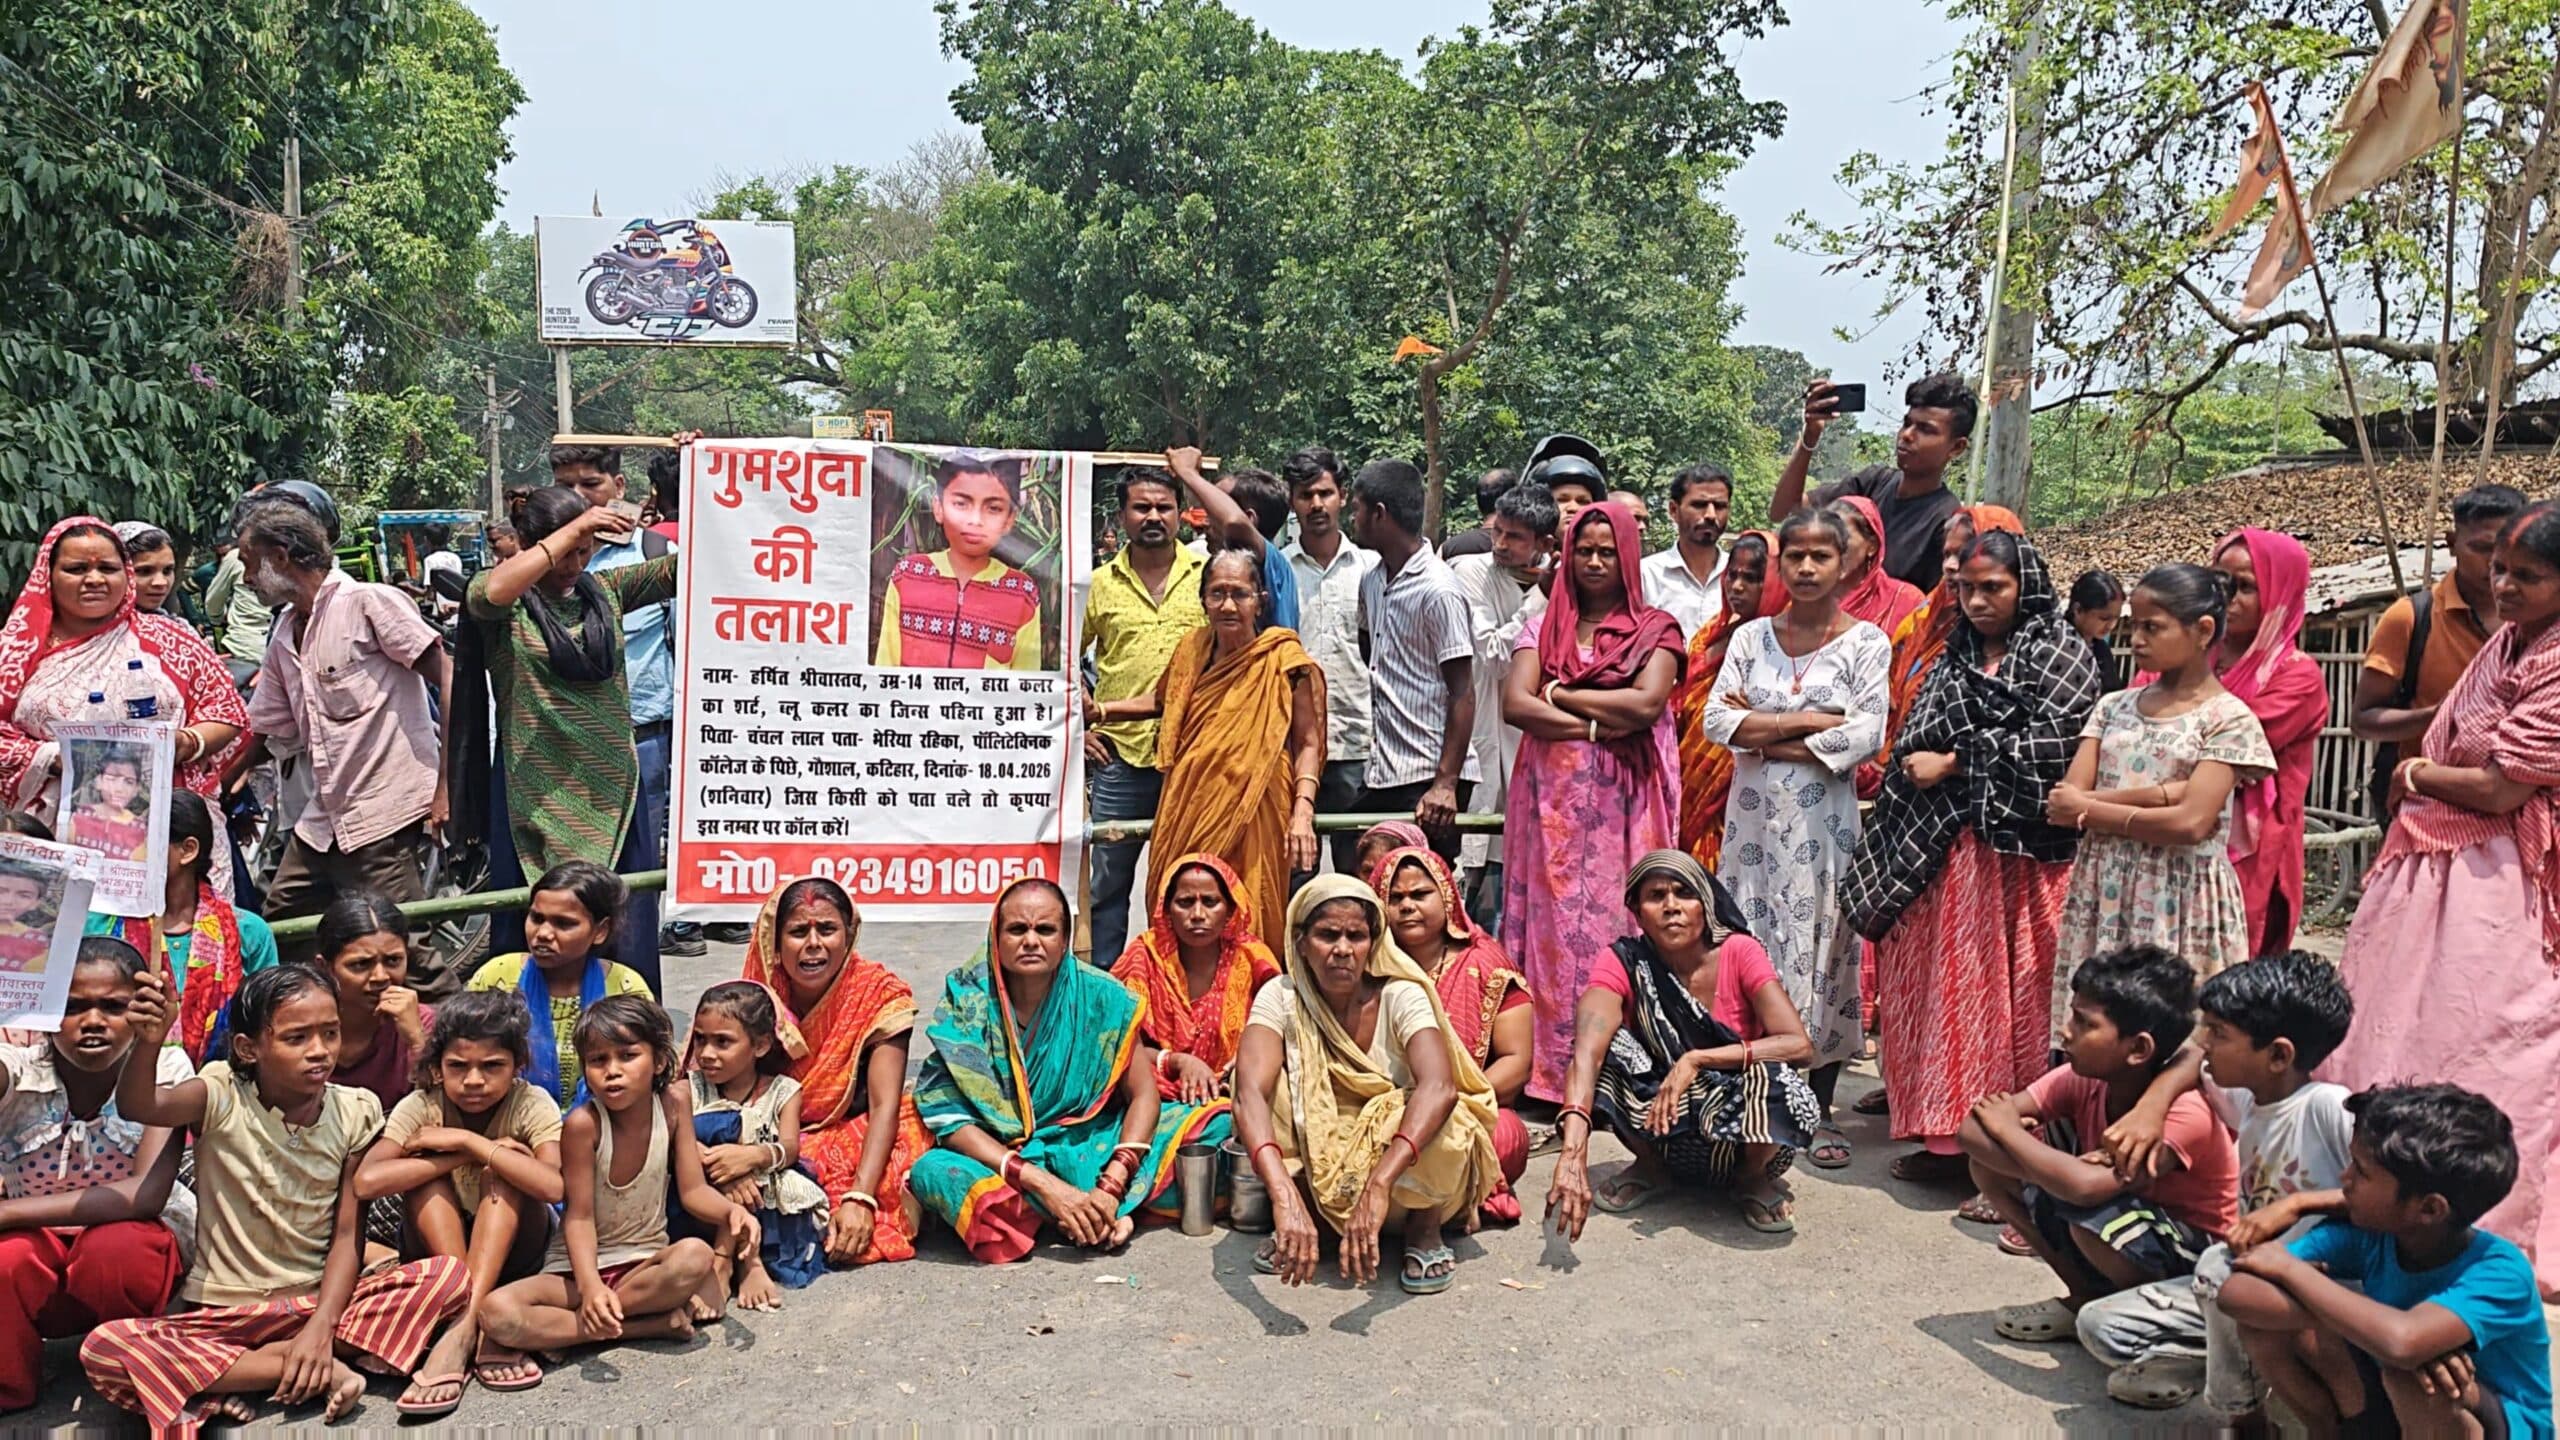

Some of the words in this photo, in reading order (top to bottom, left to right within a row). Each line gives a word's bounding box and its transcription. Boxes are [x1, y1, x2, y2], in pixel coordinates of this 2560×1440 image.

[705, 446, 867, 513] गुमशुदा
[751, 525, 818, 584] की
[711, 597, 853, 645] तलाश
[702, 668, 739, 684] नाम-
[750, 666, 790, 686] हर्षित
[799, 667, 868, 692] श्रीवास्तव,
[933, 676, 970, 694] साल,
[981, 677, 1009, 693] हारा
[1018, 678, 1054, 693] कलर
[701, 698, 724, 714] का
[733, 695, 766, 718] शर्ट,
[810, 701, 849, 718] कलर
[858, 702, 880, 718] का
[890, 699, 930, 719] जिन्स
[940, 701, 984, 721] पहिना
[994, 706, 1027, 726] हुआ
[104, 722, 150, 738] शनिवार
[156, 725, 168, 739] से
[700, 724, 739, 744] पिता-
[747, 725, 785, 746] चंचल
[791, 730, 825, 746] लाल
[832, 731, 864, 747] पता-
[873, 728, 913, 748] भेरिया
[919, 730, 964, 752] रहिका,
[699, 755, 748, 775] कॉलेज
[751, 755, 767, 775] के
[770, 756, 802, 779] पिछे,
[807, 757, 861, 780] गौशाल,
[865, 758, 919, 781] कटिहार,
[924, 758, 974, 779] दिनांक-
[978, 762, 1051, 779] 18.04.2026
[700, 785, 772, 809] (शनिवार)
[784, 786, 818, 806] जिस
[828, 786, 867, 806] किसी
[877, 788, 898, 807] को
[908, 792, 936, 807] पता
[946, 789, 971, 808] चले
[981, 789, 999, 808] तो
[1009, 793, 1052, 812] कृपया
[697, 819, 720, 836] इस
[723, 819, 760, 836] नम्बर
[763, 820, 781, 836] पर
[784, 817, 818, 836] कॉल
[4, 841, 64, 860] शनिवार
[74, 850, 89, 867] से
[0, 976, 46, 991] ीवास्तव
